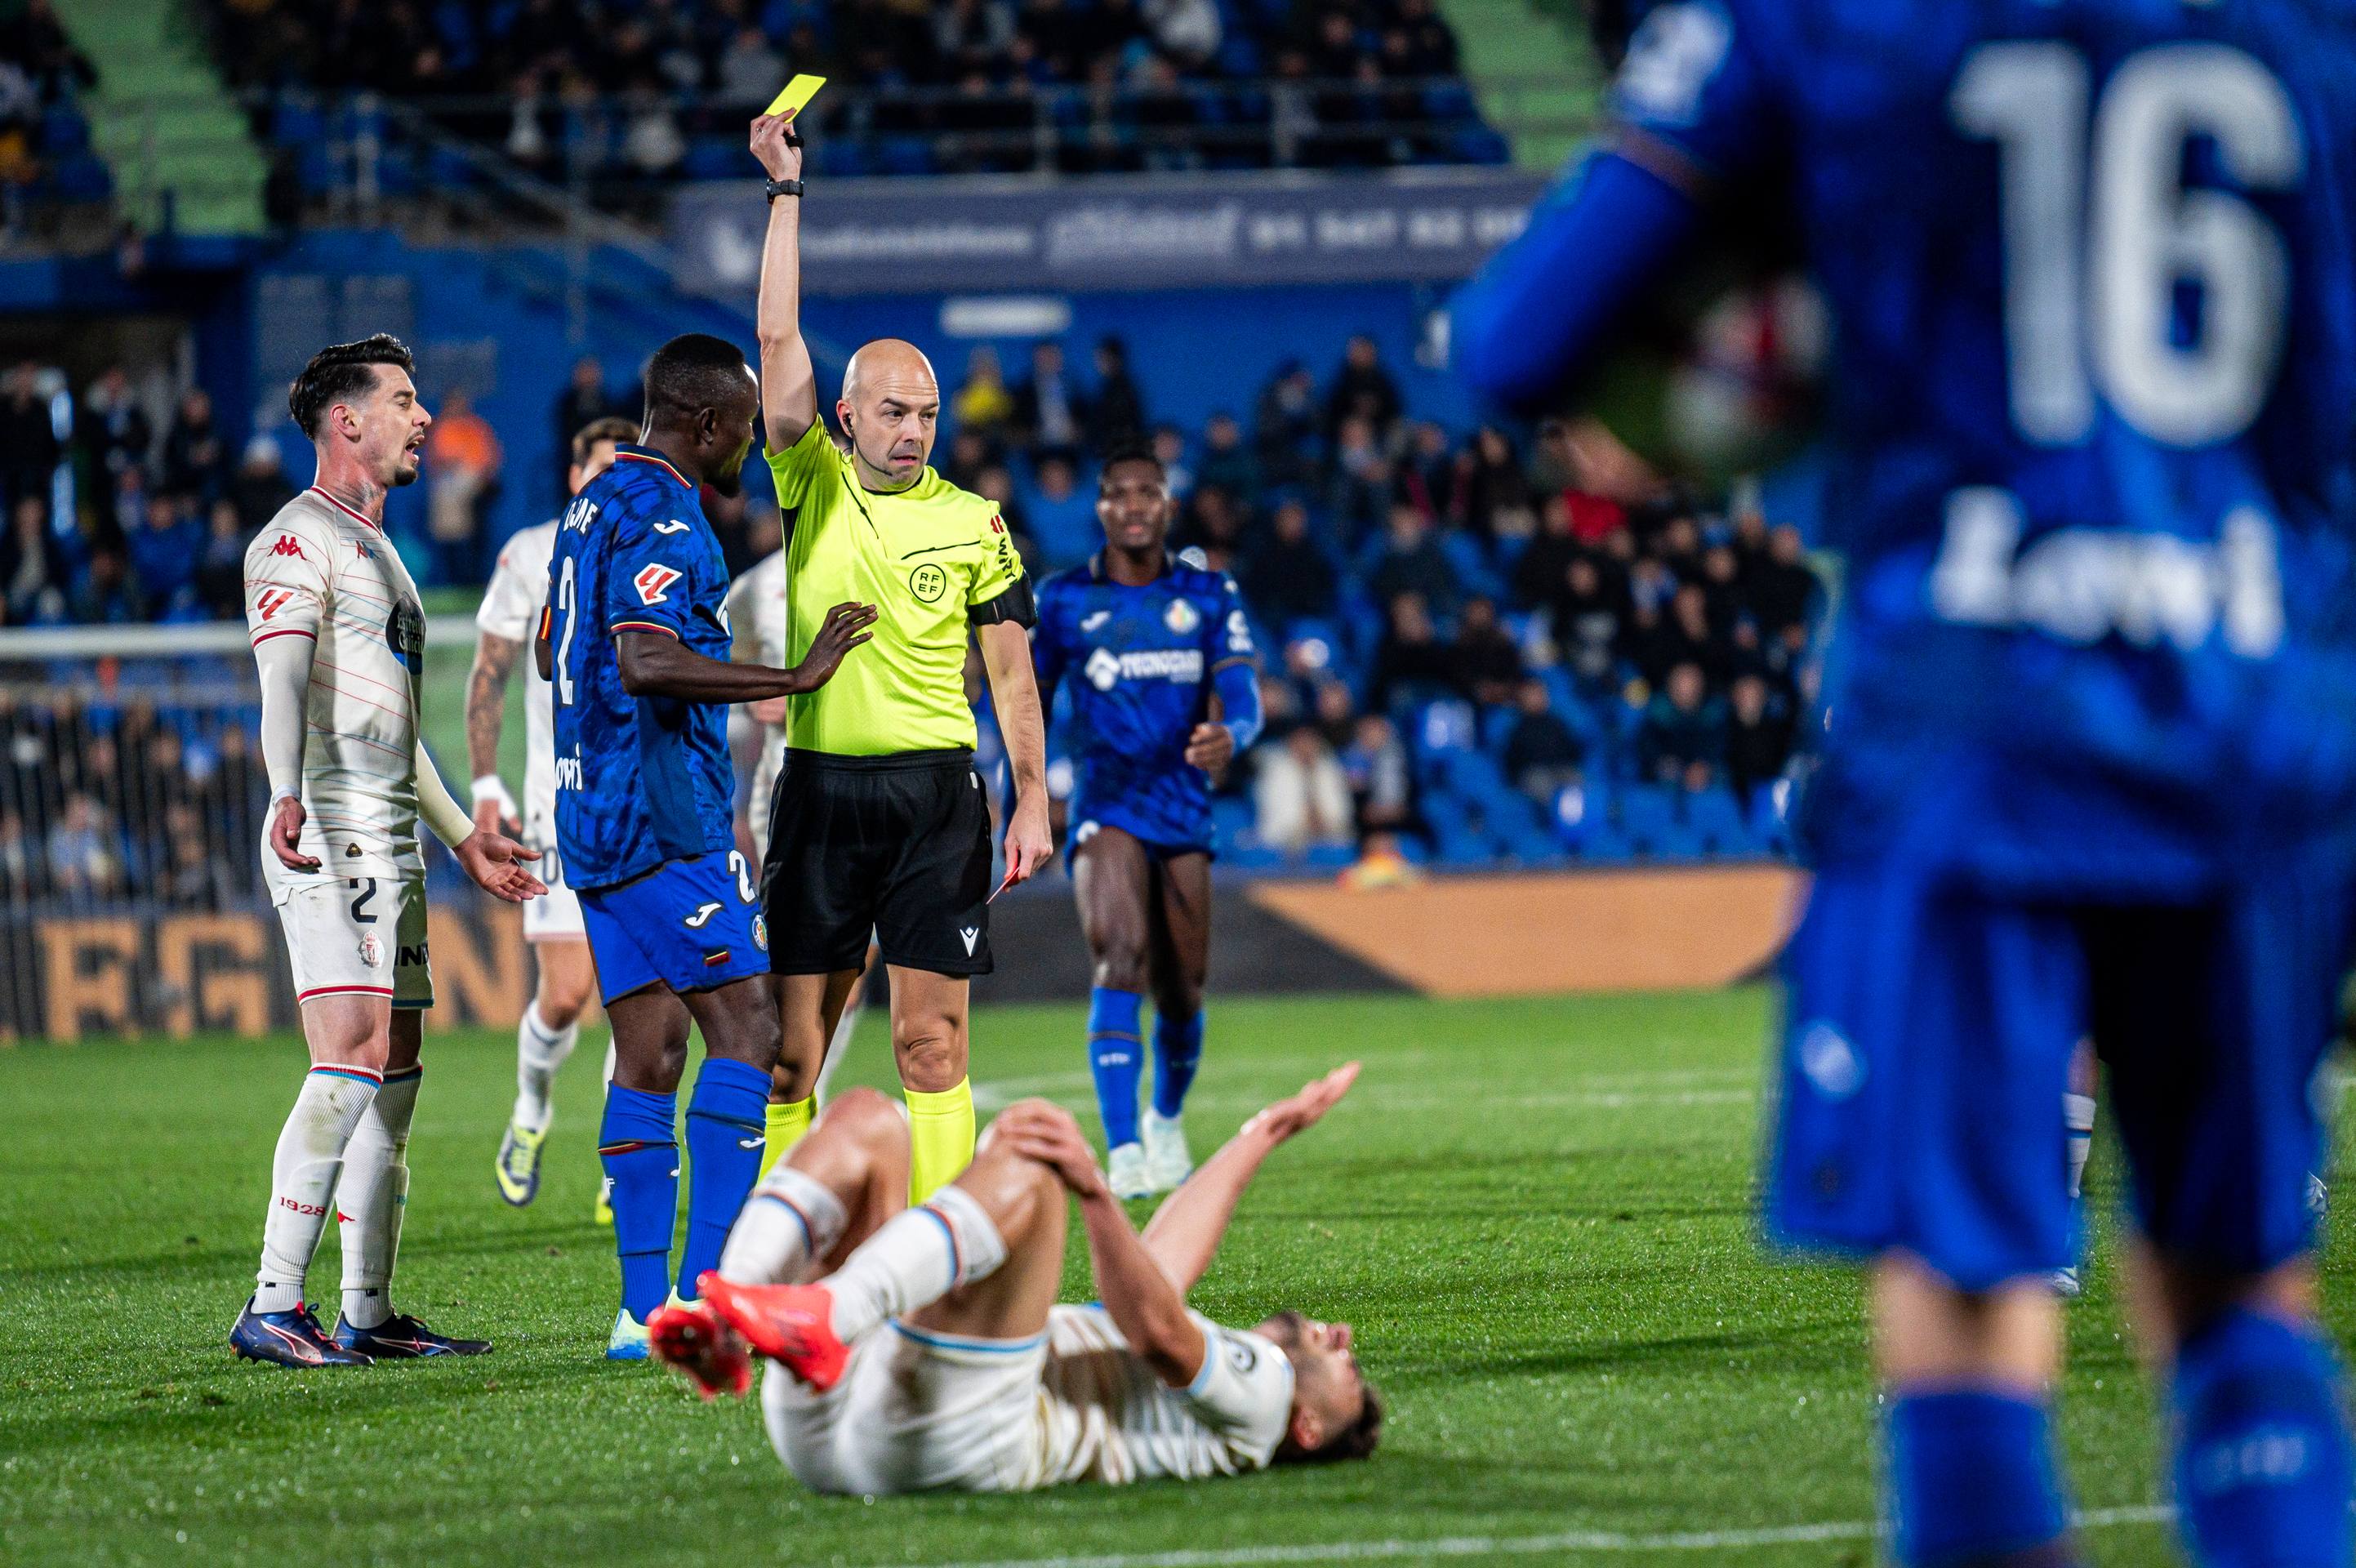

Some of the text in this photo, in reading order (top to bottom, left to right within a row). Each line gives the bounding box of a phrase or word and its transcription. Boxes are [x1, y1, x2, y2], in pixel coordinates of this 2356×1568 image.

[1953, 42, 2303, 448] 16
[558, 556, 576, 705] 2
[555, 742, 582, 791] owi
[350, 877, 378, 923] 2
[729, 850, 755, 902] 2
[280, 1196, 326, 1218] 1928
